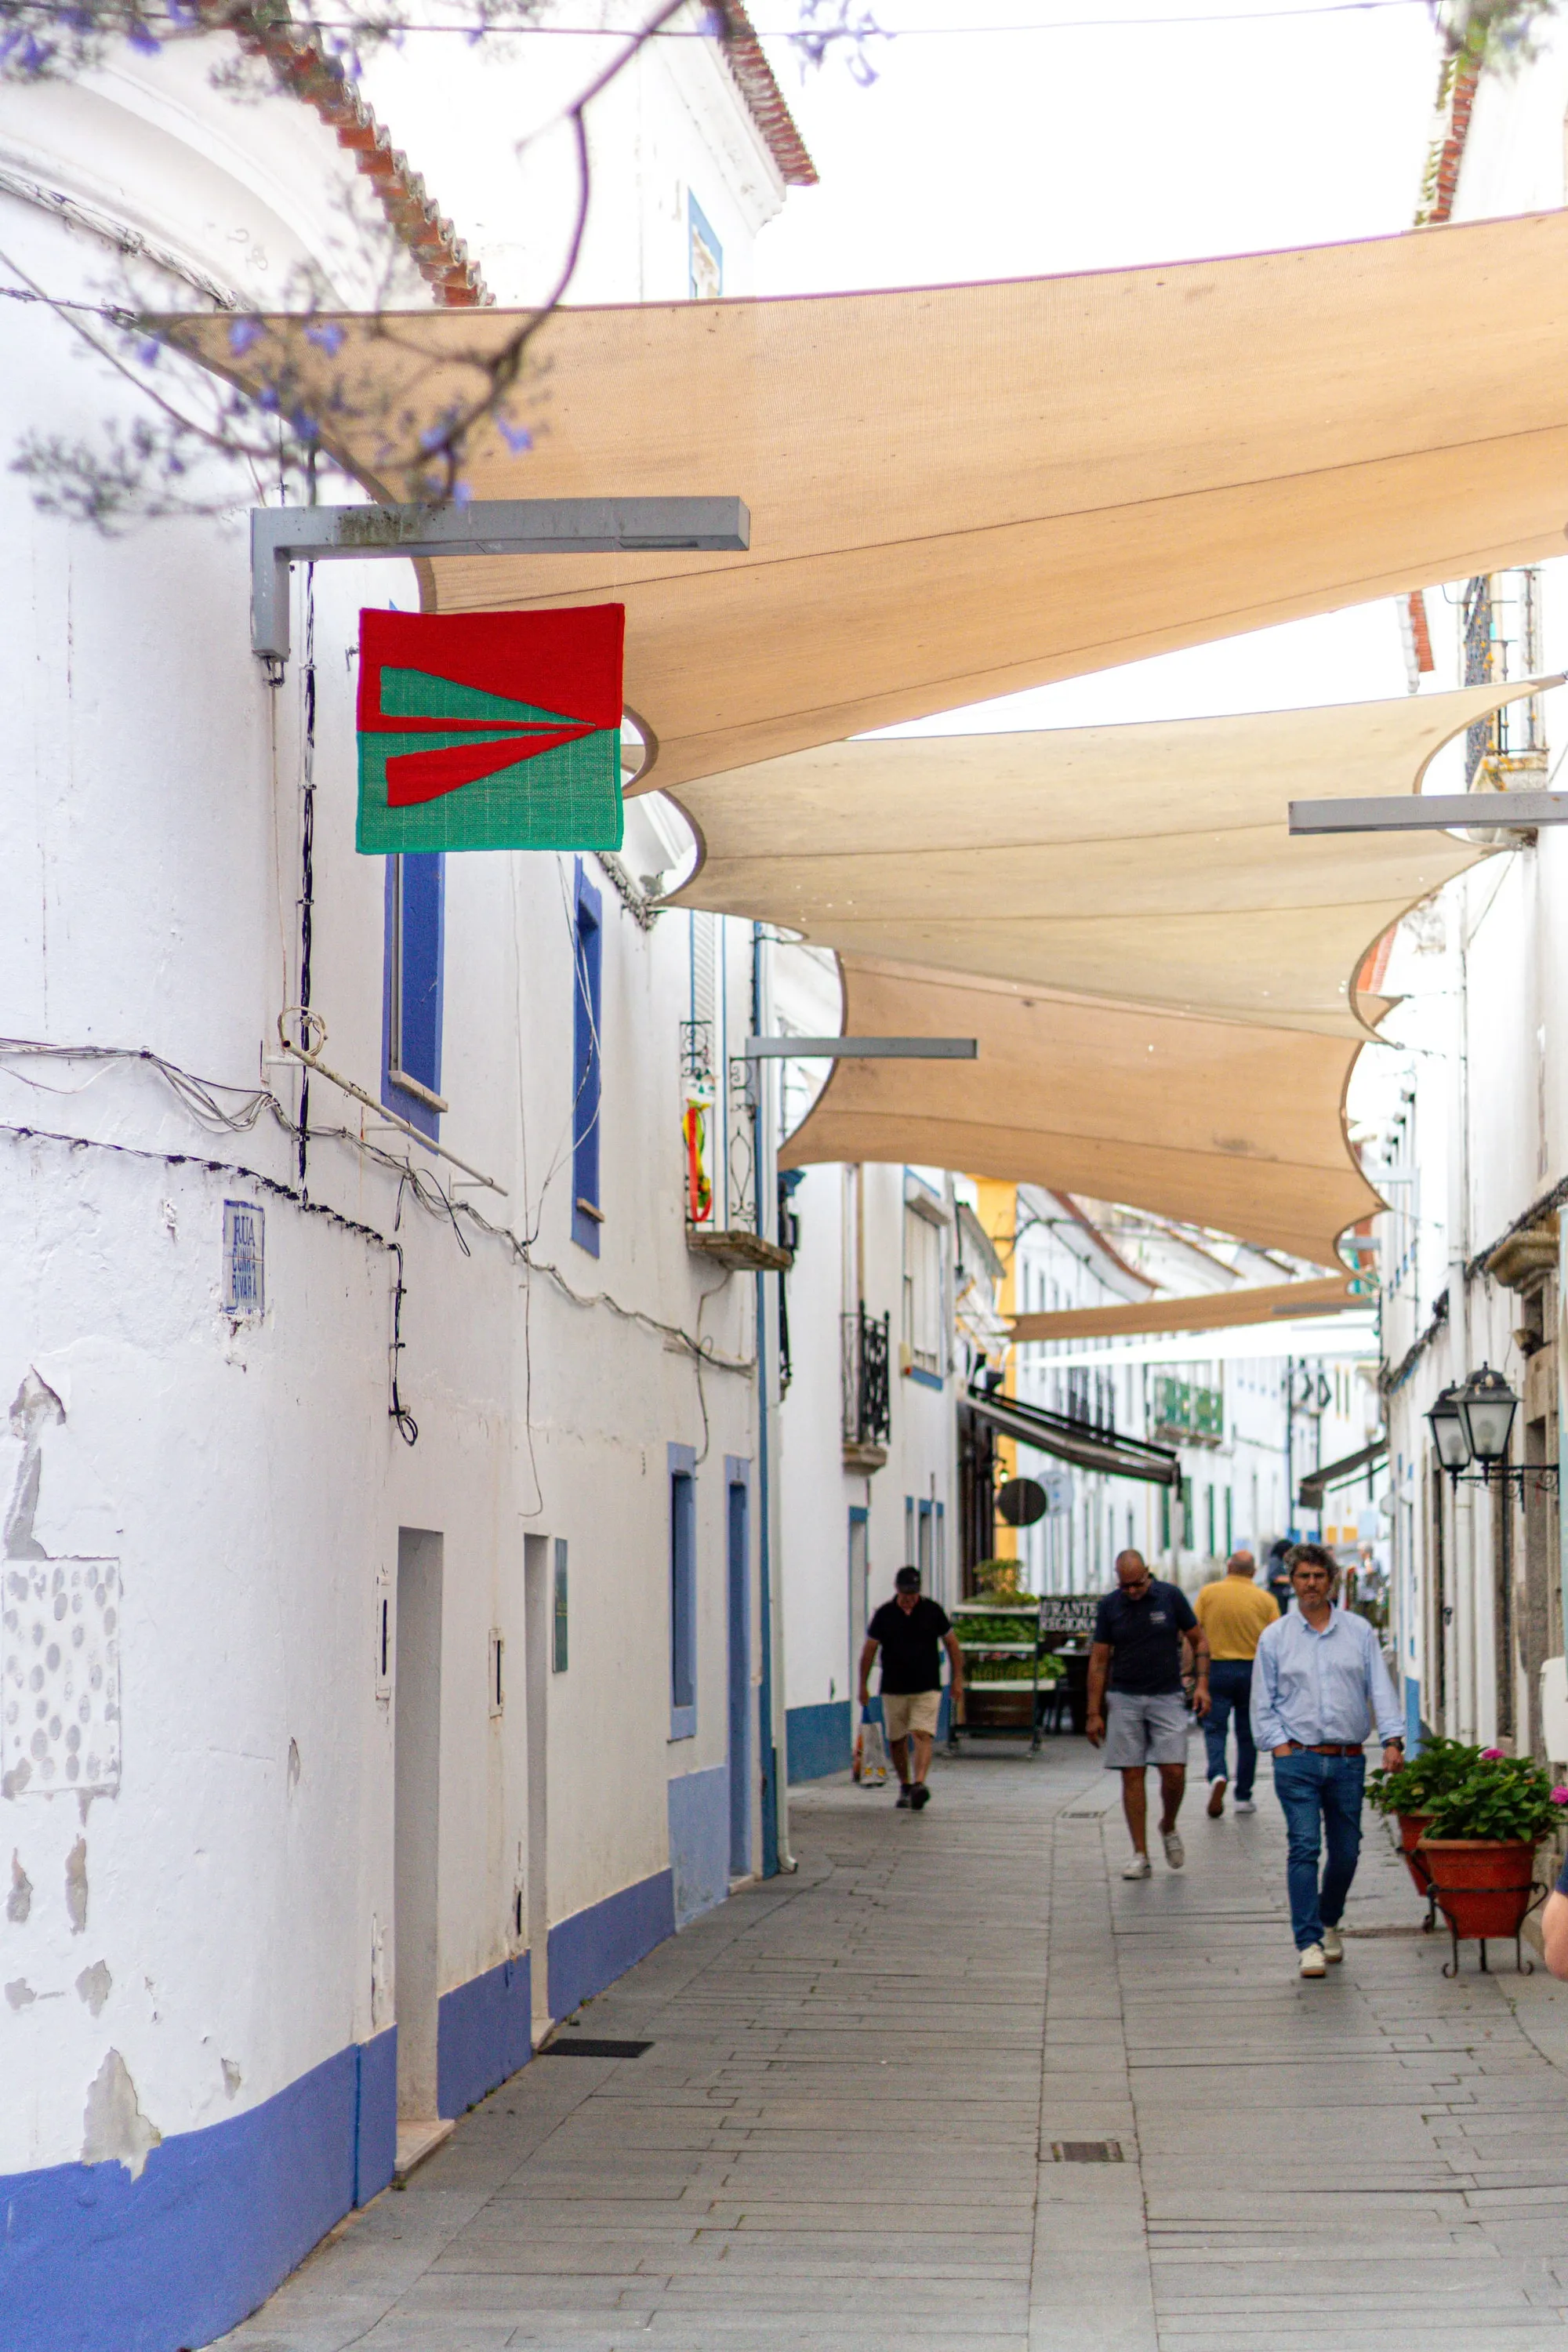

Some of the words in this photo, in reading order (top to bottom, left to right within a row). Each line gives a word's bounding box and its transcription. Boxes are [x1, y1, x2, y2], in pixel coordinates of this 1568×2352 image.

[234, 1215, 256, 1247] RUA
[232, 1247, 256, 1272] CUNHA
[232, 1275, 257, 1300] RIVARA
